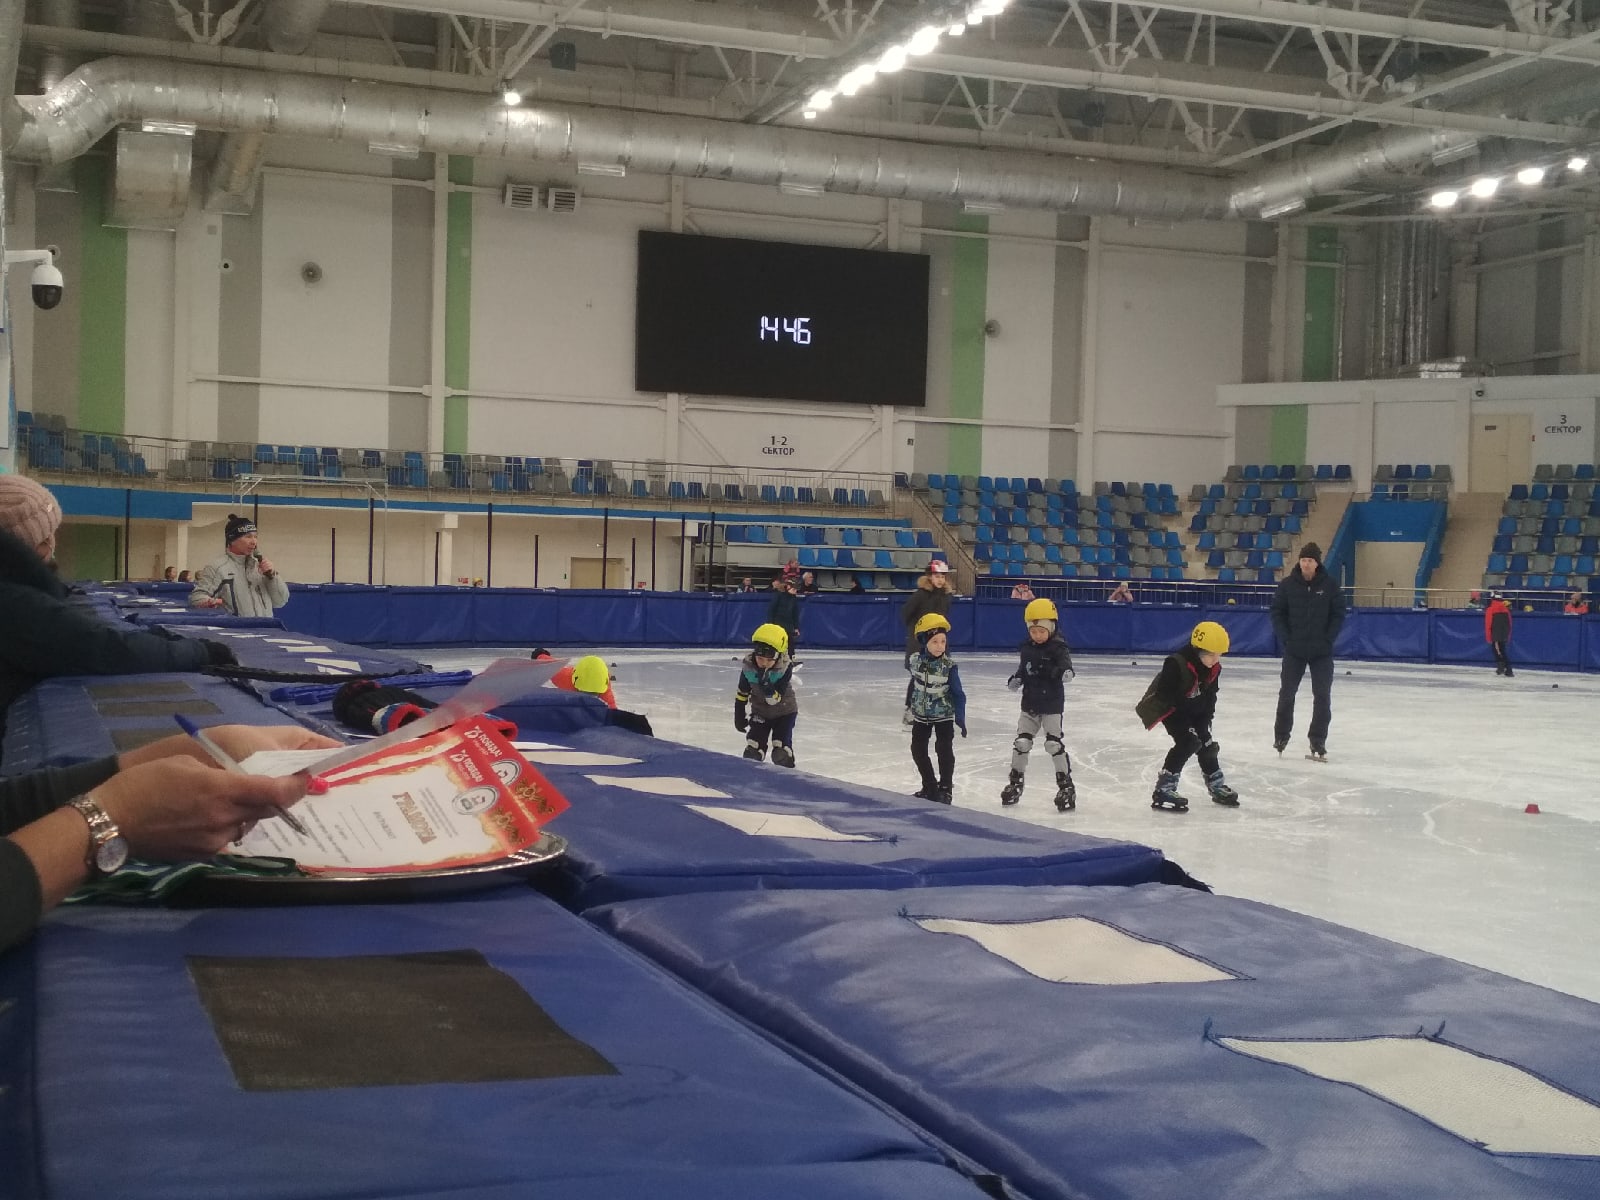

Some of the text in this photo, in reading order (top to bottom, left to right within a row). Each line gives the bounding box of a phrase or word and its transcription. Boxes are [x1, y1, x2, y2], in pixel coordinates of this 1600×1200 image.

[1560, 414, 1567, 425] 3
[1544, 425, 1582, 434] СЕКТОР
[771, 435, 788, 446] 1-2
[762, 446, 795, 456] СЕКТОР
[1193, 629, 1206, 642] 55
